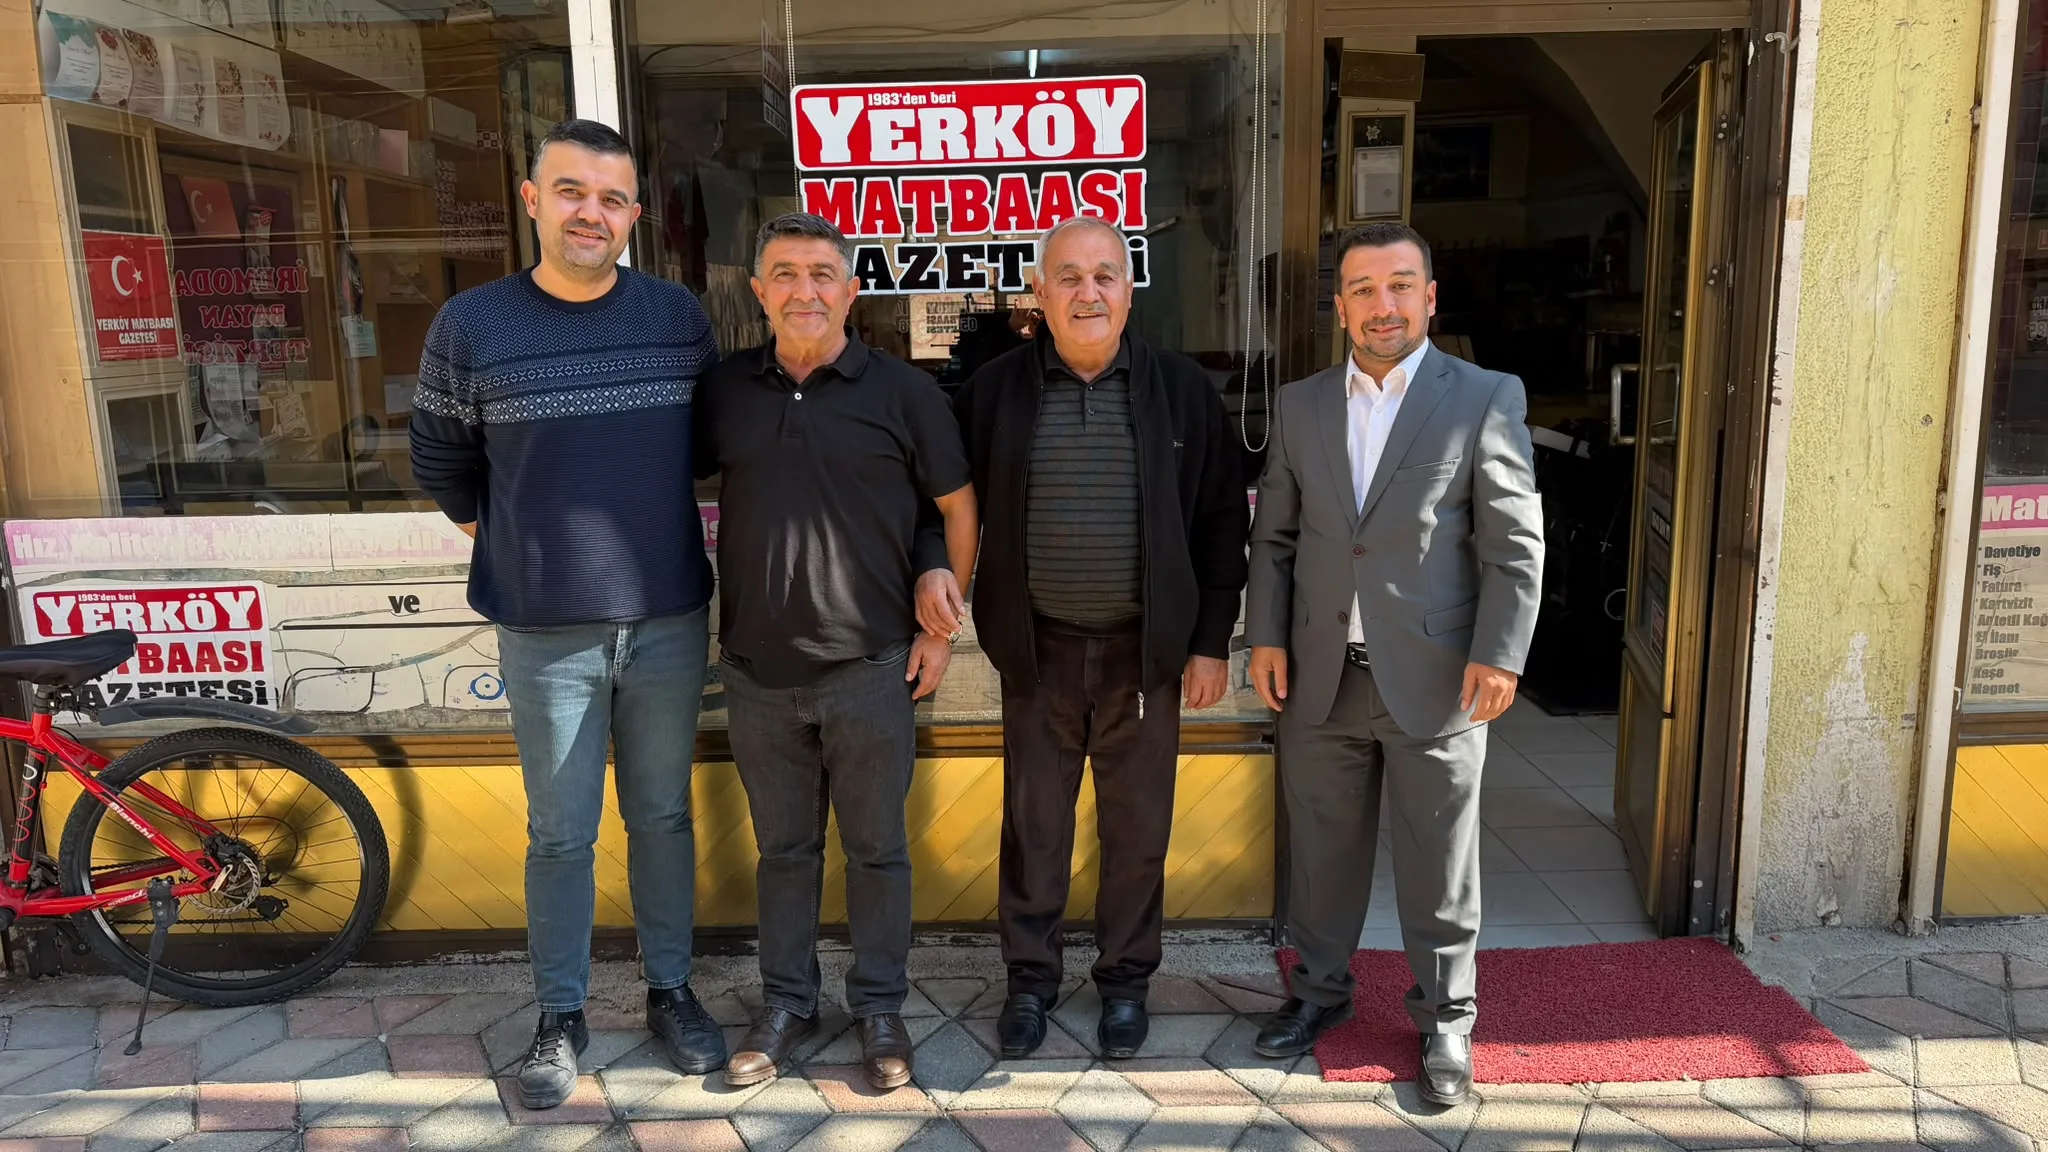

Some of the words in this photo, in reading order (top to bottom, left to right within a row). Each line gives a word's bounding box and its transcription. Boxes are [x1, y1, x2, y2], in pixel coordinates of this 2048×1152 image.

[867, 92, 927, 106] 1983'den
[929, 90, 957, 104] beri
[801, 86, 1140, 164] YERKÖY
[802, 170, 1147, 237] MATBAASI
[96, 315, 130, 330] YERKÖY
[131, 317, 174, 330] MATBAASI
[1984, 545, 2041, 558] Davetiye
[1982, 564, 2001, 578] Fiş
[1981, 581, 2022, 593] Fatura
[78, 593, 117, 602] 1983'den
[118, 592, 137, 601] beri
[388, 594, 421, 613] ve
[1979, 597, 2034, 609] Kartvizit
[36, 590, 257, 634] YERKÖY
[108, 801, 155, 840] Bianchi
